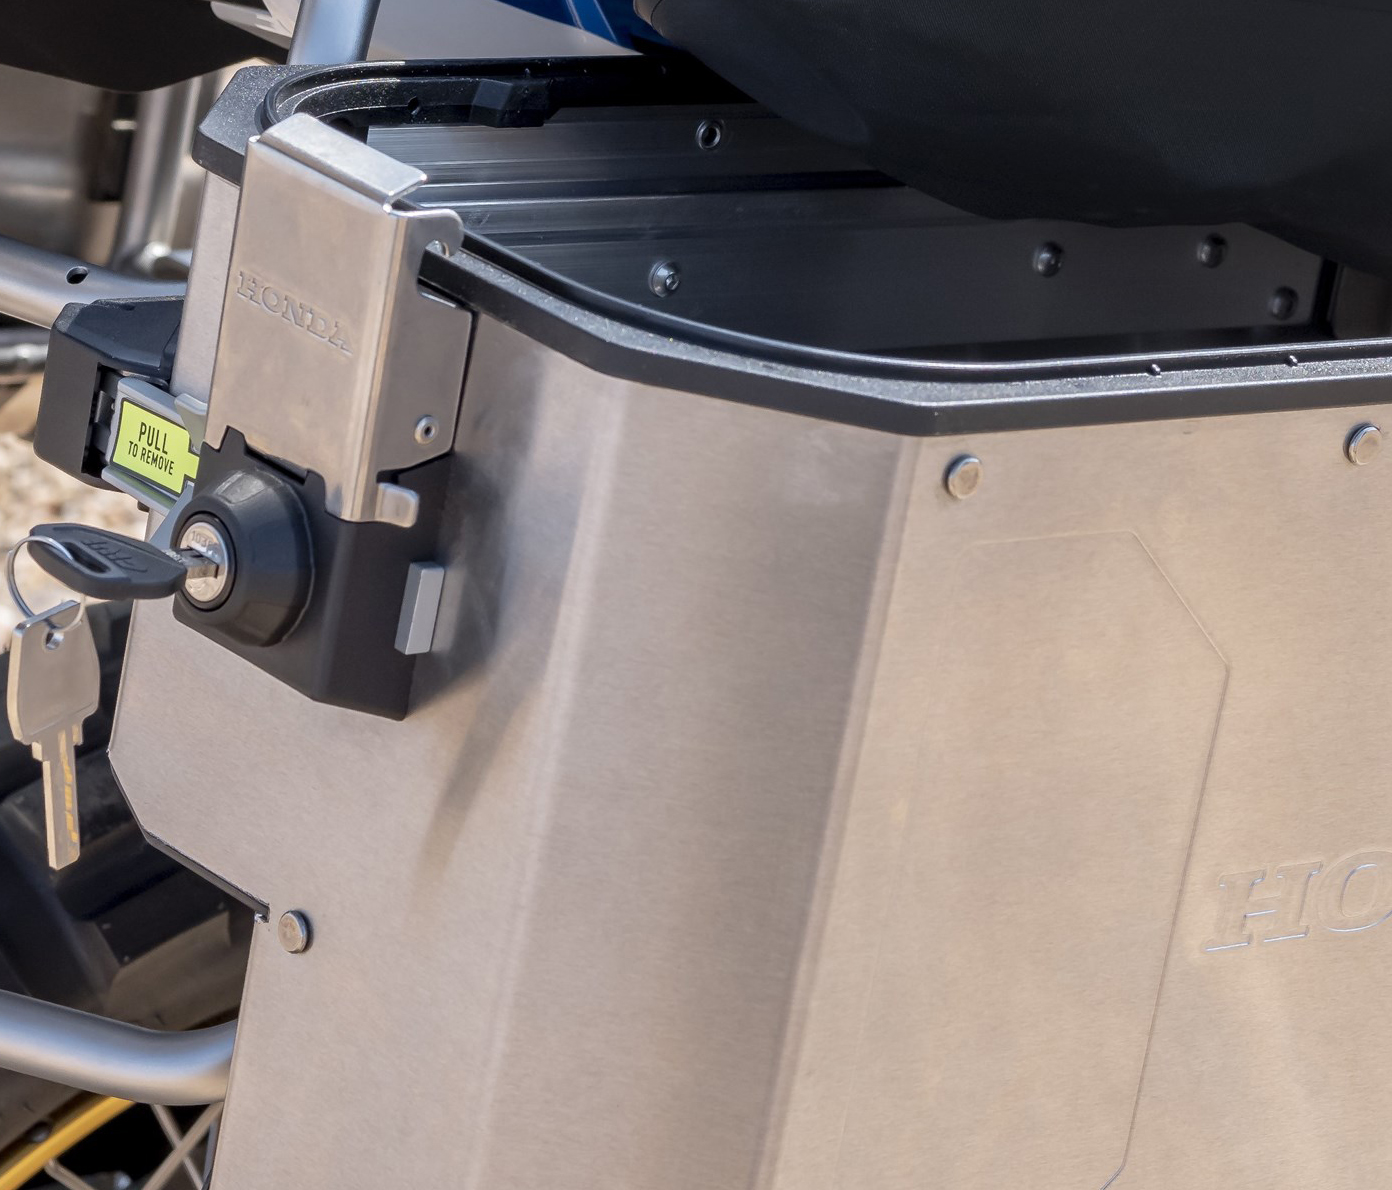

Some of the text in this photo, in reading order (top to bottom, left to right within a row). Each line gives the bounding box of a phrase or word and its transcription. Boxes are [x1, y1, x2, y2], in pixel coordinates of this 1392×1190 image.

[237, 270, 353, 356] HONDA
[138, 421, 168, 455] PULL
[127, 440, 175, 476] TO REMOVE
